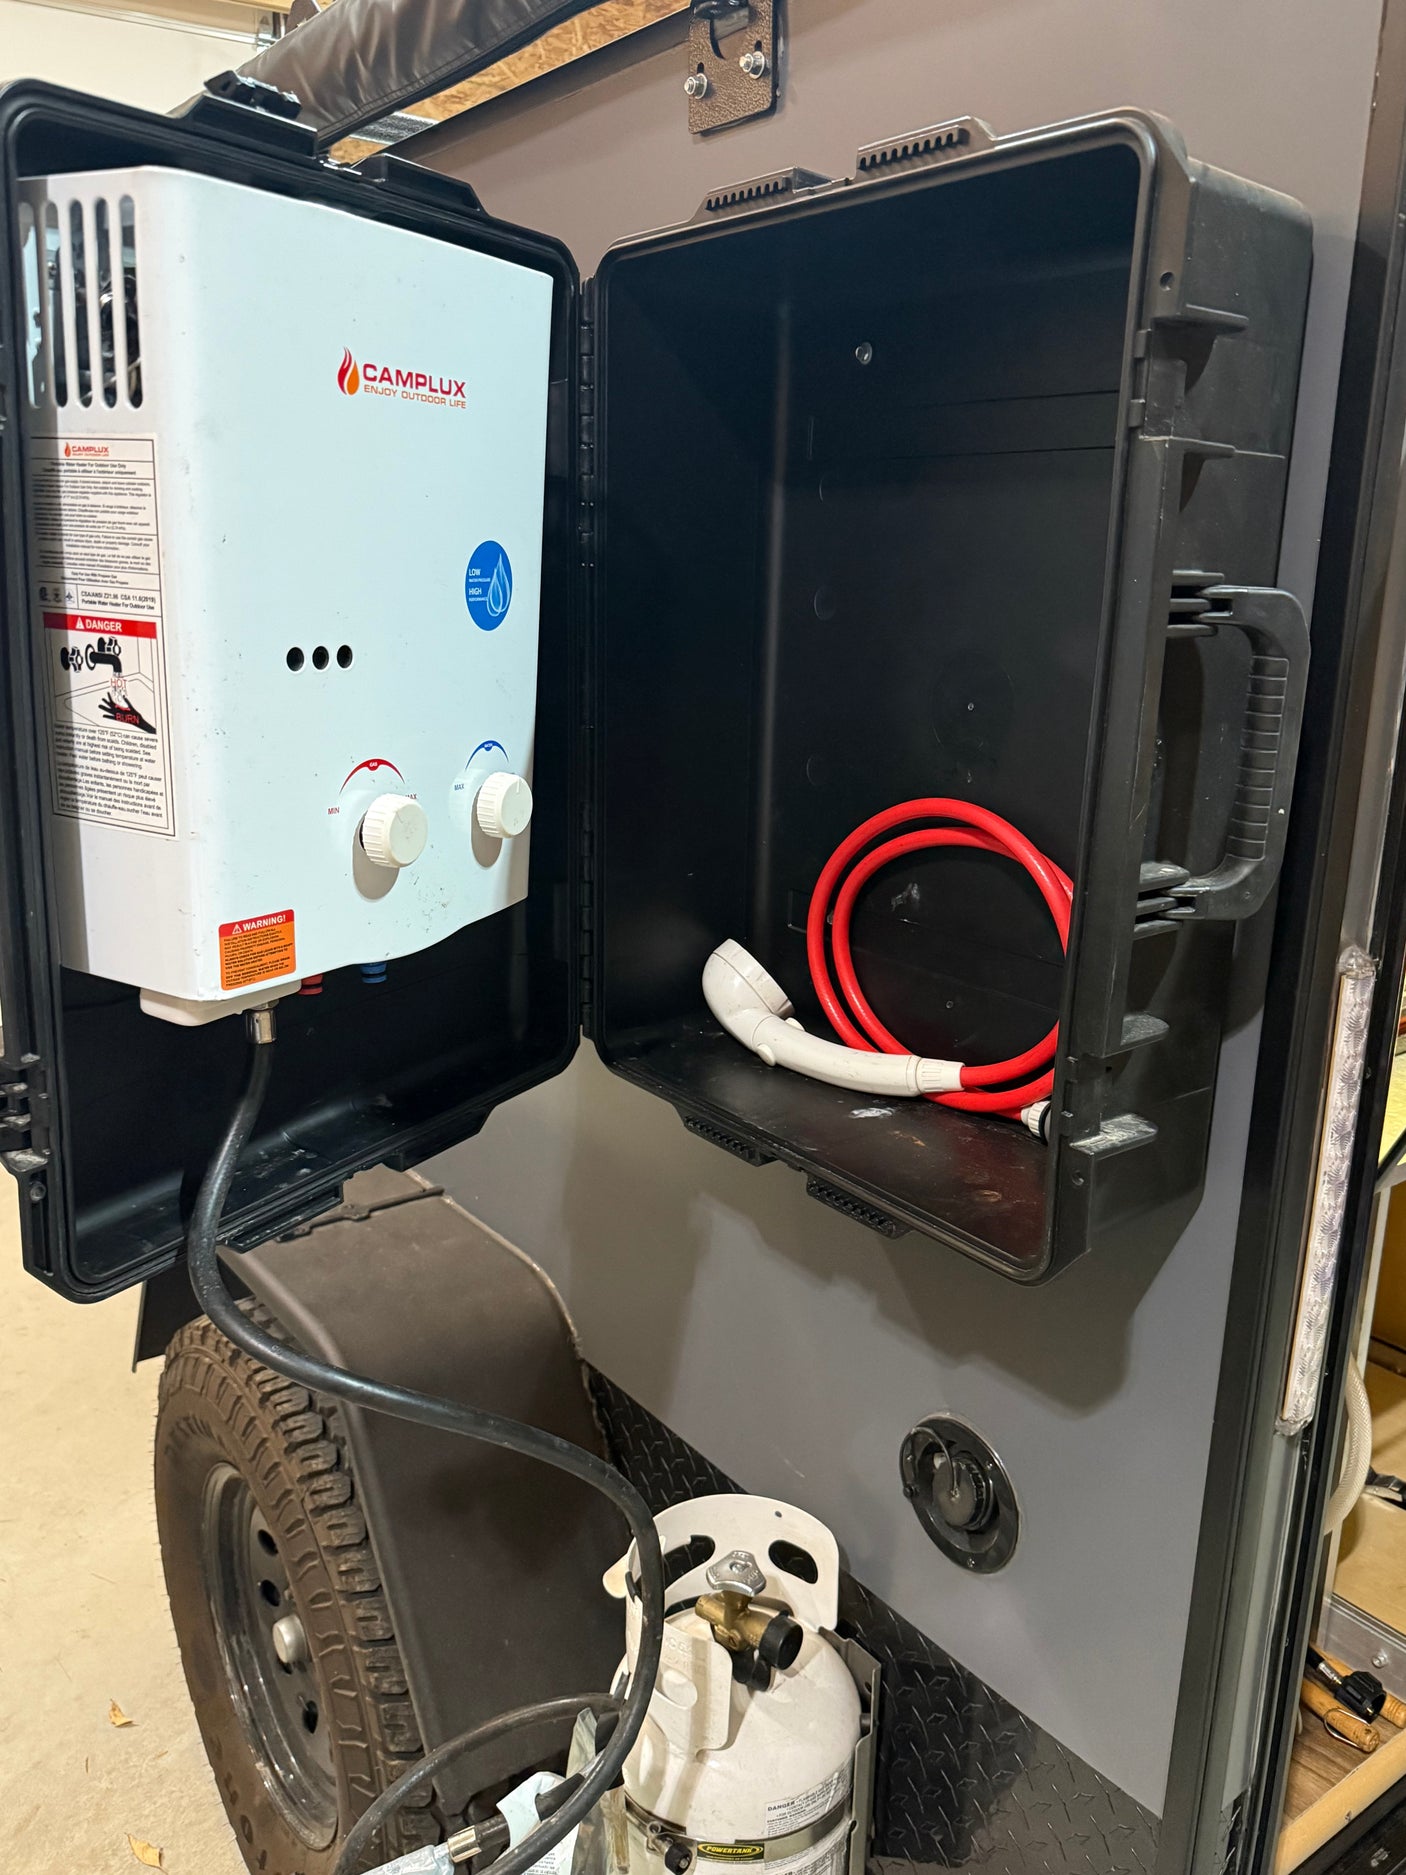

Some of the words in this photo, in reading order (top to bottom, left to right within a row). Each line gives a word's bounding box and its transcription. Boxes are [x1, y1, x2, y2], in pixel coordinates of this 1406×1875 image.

[363, 363, 466, 398] CAMPLUX
[364, 384, 398, 397] ENJOY
[401, 390, 446, 405] OUTDOOR
[449, 399, 466, 409] LIFE
[86, 619, 122, 632] DANGER
[111, 678, 127, 689] HOT
[116, 712, 139, 724] BURN
[327, 806, 340, 815] MIN
[242, 915, 286, 931] WARNING!
[768, 1800, 795, 1811] DANGER
